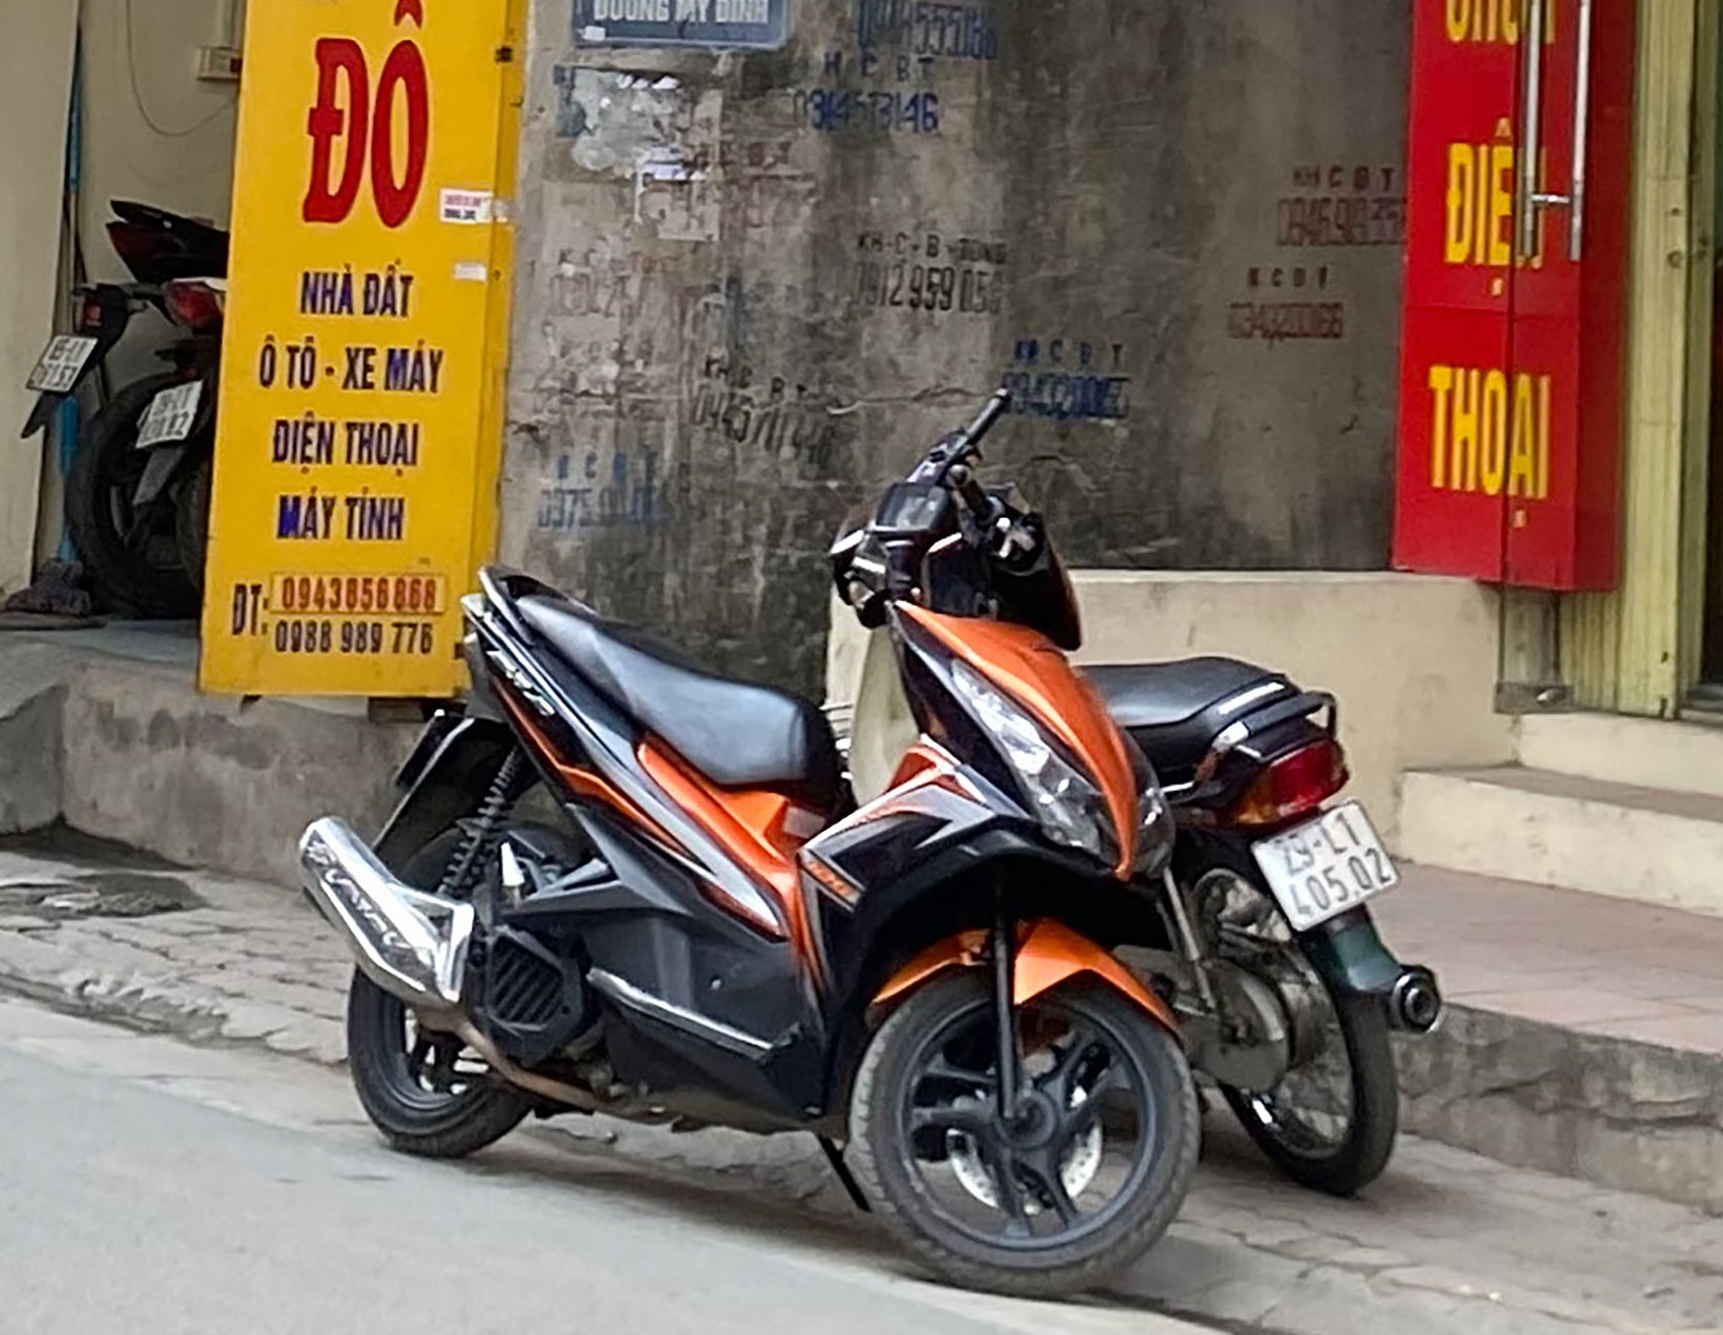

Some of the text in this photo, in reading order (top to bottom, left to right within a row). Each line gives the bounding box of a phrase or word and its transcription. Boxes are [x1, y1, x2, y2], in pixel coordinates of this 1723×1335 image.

[300, 258, 413, 317] NHÀ ĐẤT
[287, 336, 316, 389] TÔ
[344, 347, 376, 391] XE
[385, 339, 444, 393] MÁY
[272, 411, 419, 477] ĐIỆN THOẠI
[1429, 365, 1551, 528] THOẠI
[277, 486, 404, 540] MÁY TÍNH
[391, 621, 432, 654] 776
